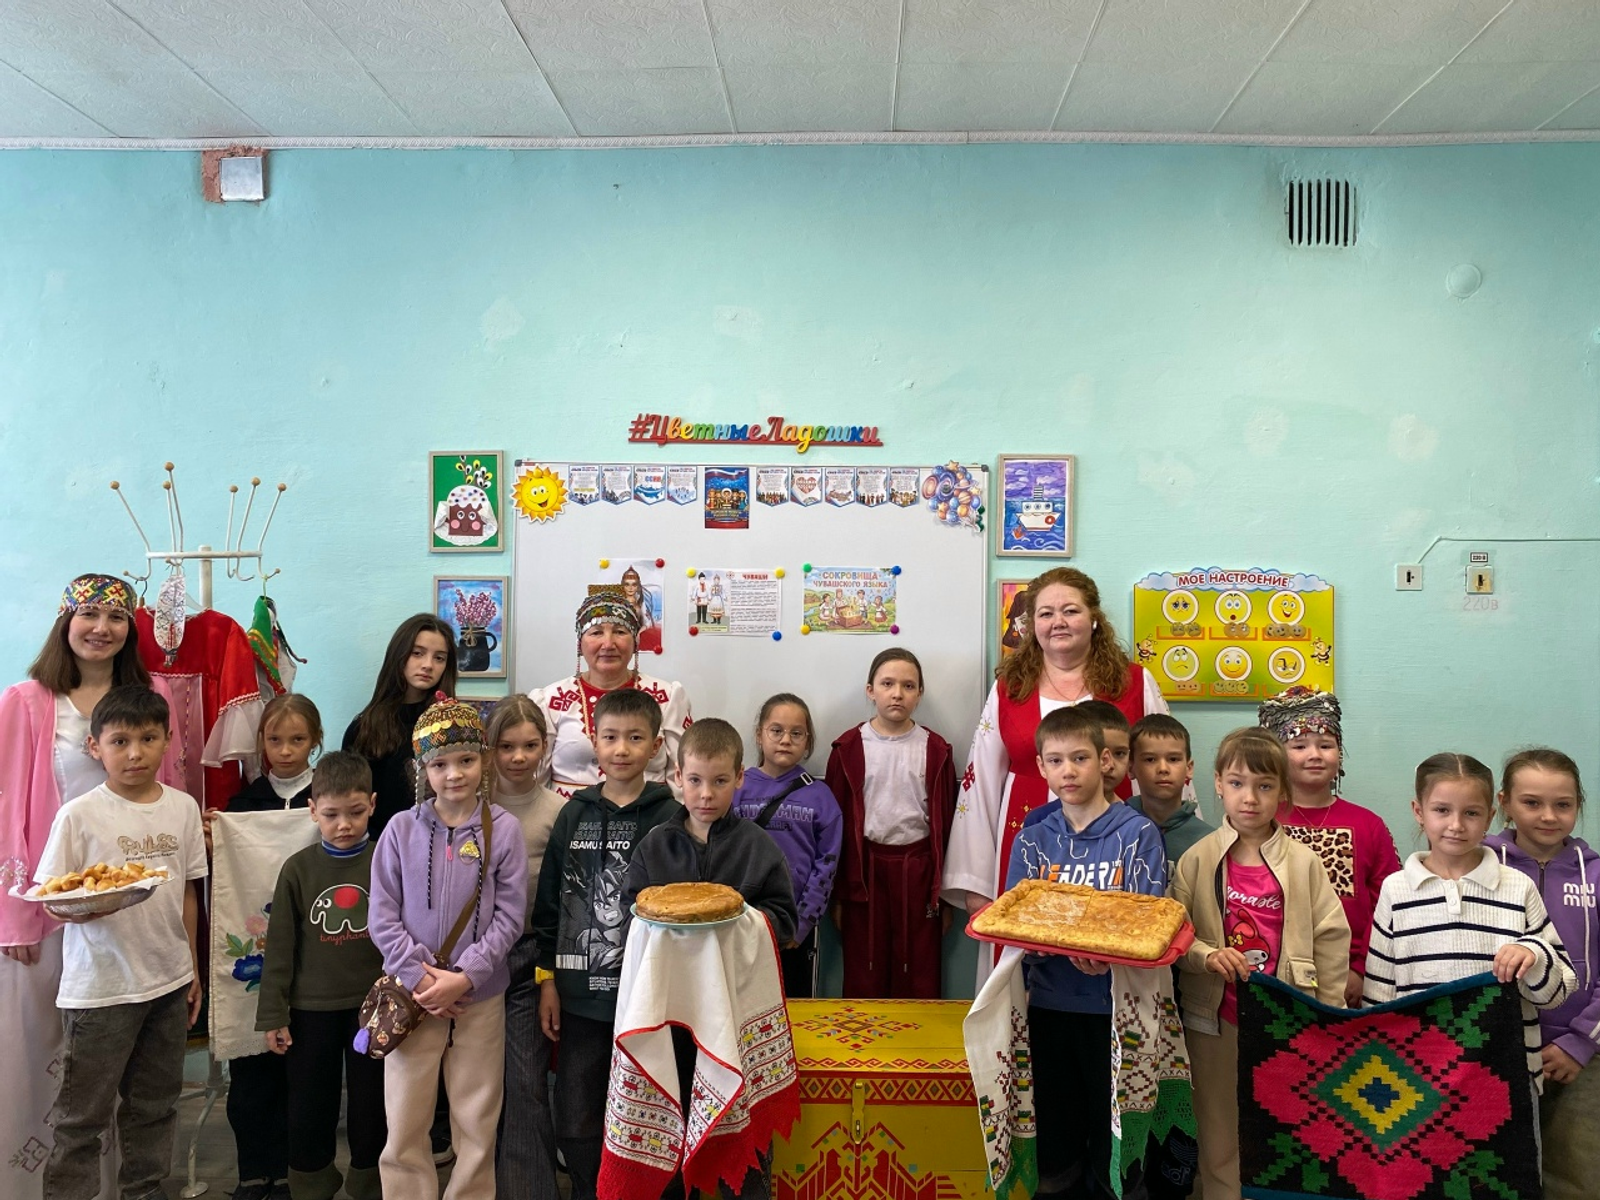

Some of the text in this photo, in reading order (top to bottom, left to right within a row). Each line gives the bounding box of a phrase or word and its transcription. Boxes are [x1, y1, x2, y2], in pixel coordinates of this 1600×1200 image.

[628, 413, 881, 453] #ЦветныеЛадошки
[822, 571, 879, 581] СОКРОВИЩА
[1178, 572, 1289, 588] МОЕ НАСТРОЕНИЕ
[813, 580, 888, 588] ЧУВАШСКОГО ЯЗЫКА
[569, 840, 598, 850] ISAMU
